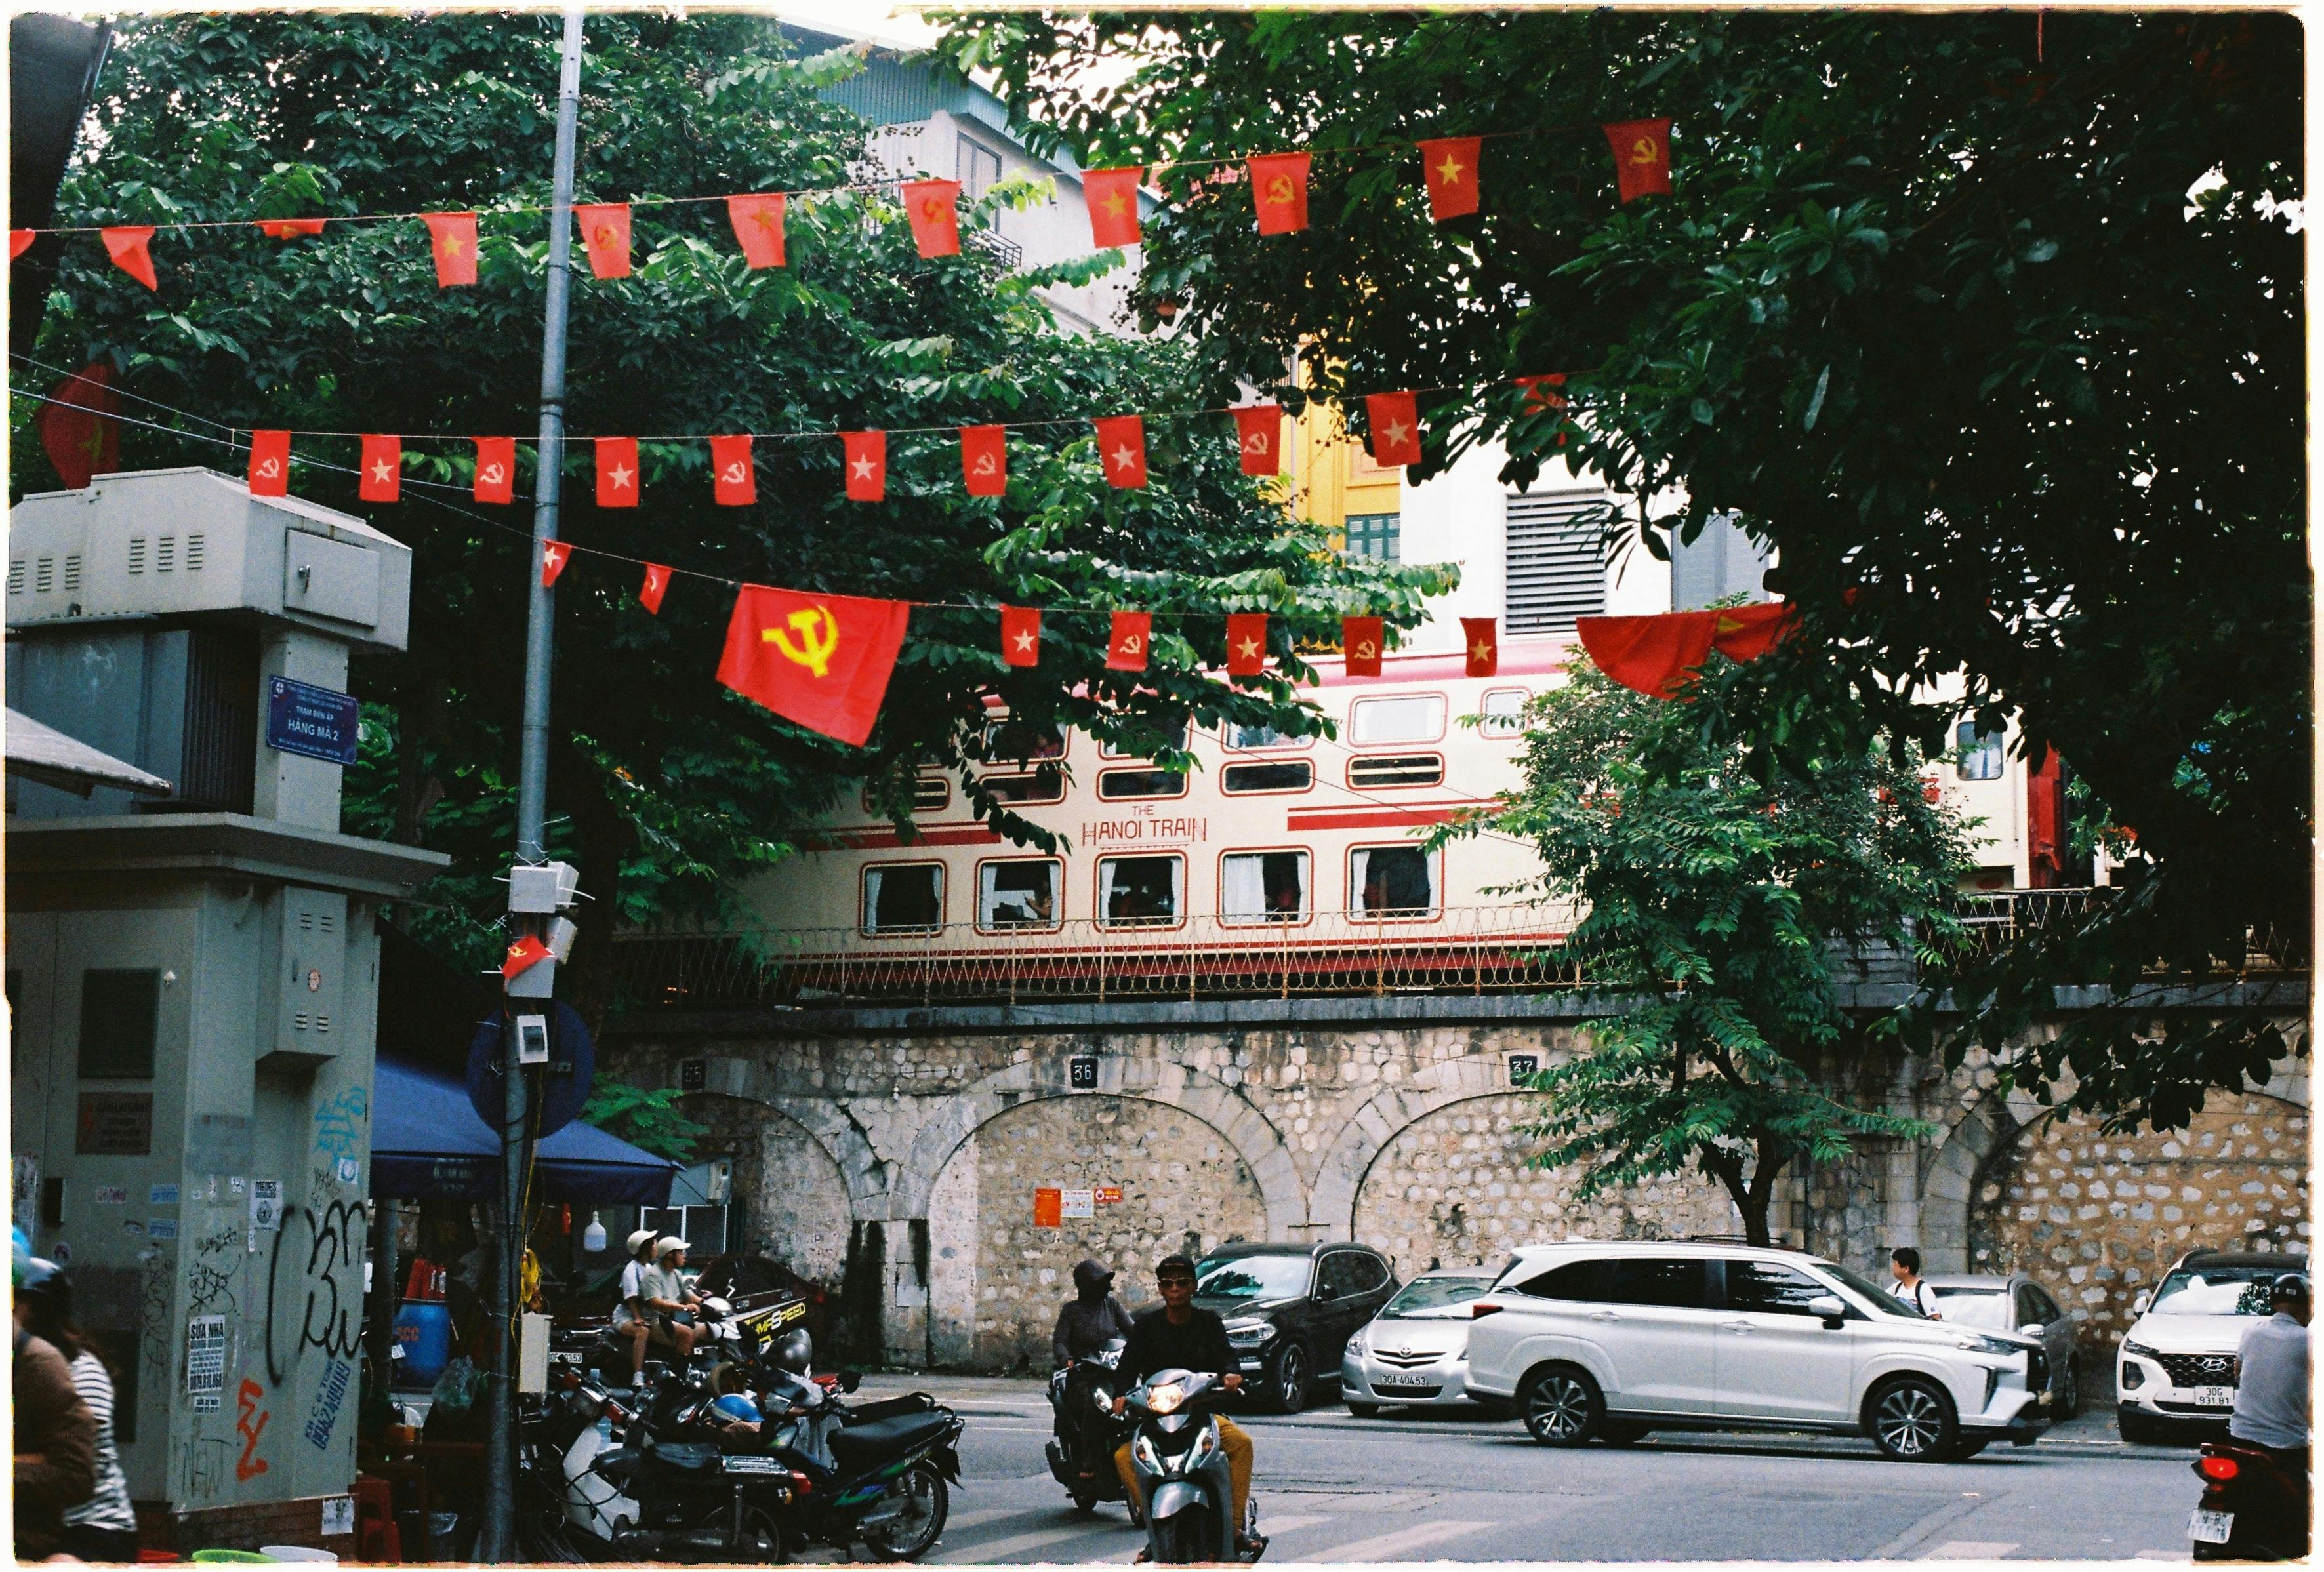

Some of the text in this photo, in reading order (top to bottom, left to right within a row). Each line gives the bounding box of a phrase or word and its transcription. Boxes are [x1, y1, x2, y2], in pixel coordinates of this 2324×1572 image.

[288, 717, 338, 741] HÀNG MÃ 2
[1132, 805, 1154, 816] THE
[1082, 818, 1207, 846] HANOI TRAIN
[685, 1066, 701, 1082] 35
[1074, 1064, 1091, 1081] 36
[1513, 1060, 1533, 1074] 37
[2199, 1396, 2229, 1405] 931.81
